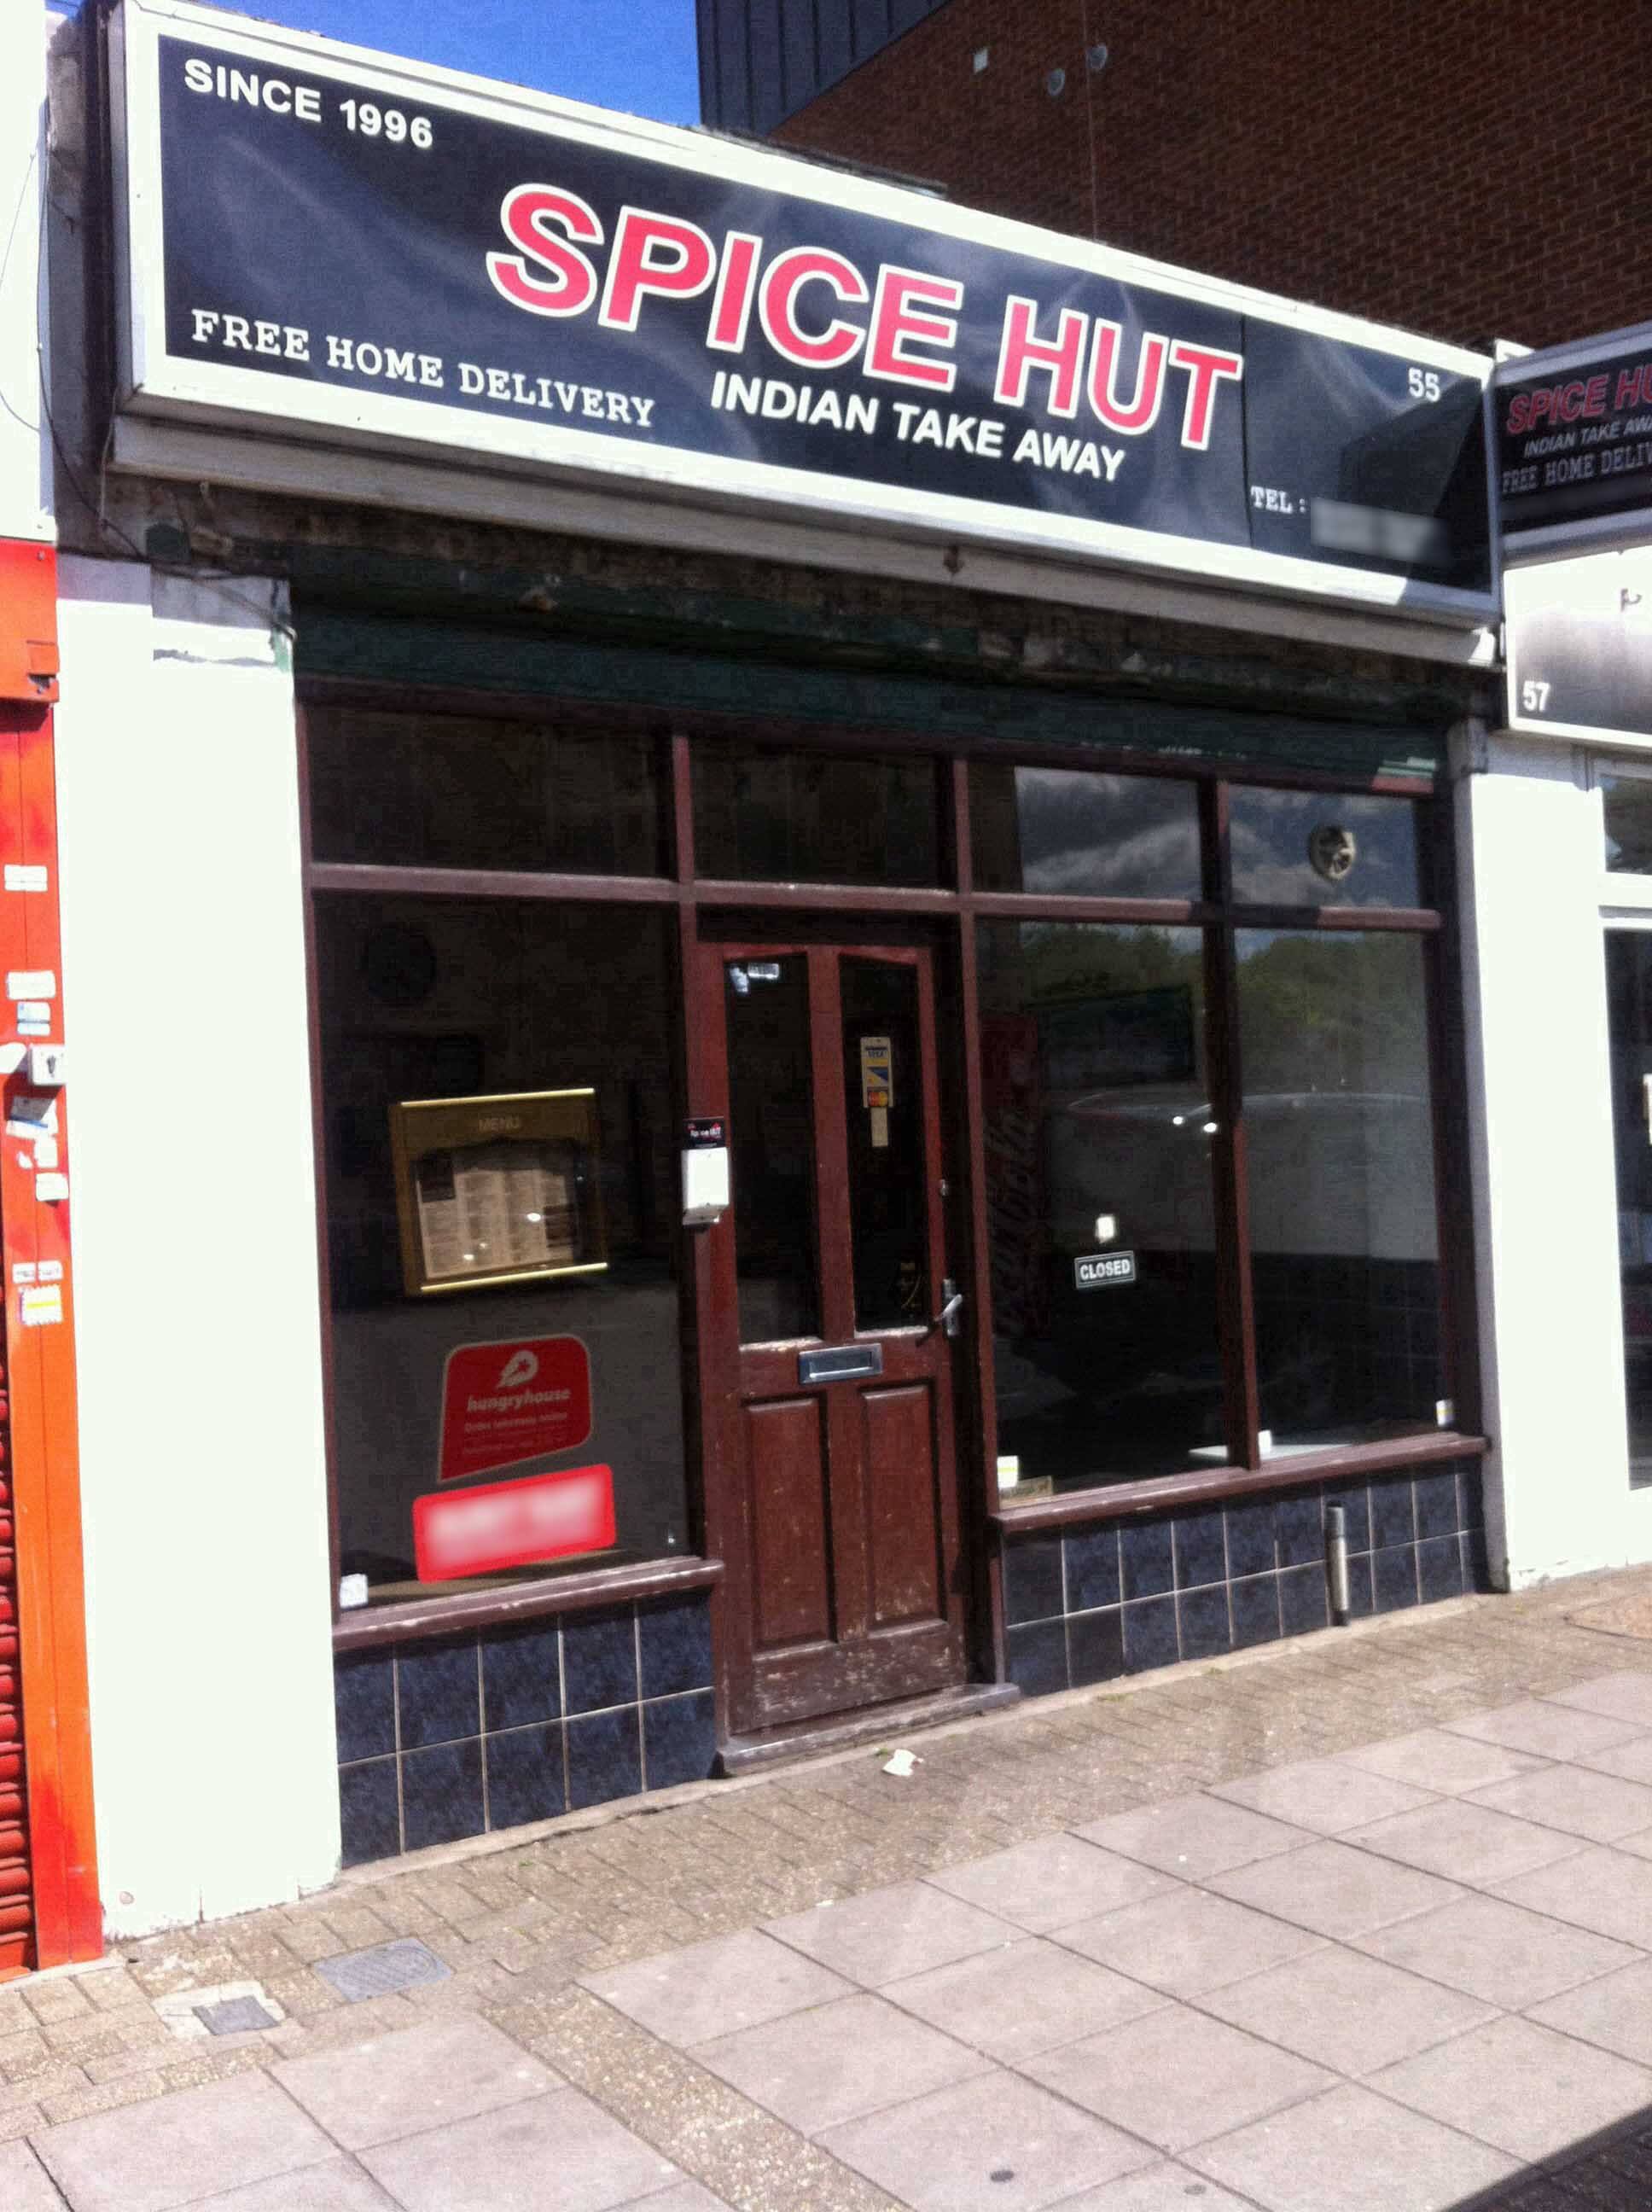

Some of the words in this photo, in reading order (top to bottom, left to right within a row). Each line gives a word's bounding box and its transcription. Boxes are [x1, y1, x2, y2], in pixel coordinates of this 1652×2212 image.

[183, 58, 323, 123] SINCE
[339, 99, 433, 148] 1996
[486, 183, 964, 393] SPICE
[993, 294, 1244, 451] HUT
[190, 309, 310, 362] FREE
[326, 335, 444, 388] HOME
[458, 363, 655, 428] DELIVERY
[1407, 367, 1440, 403] 55
[1507, 374, 1610, 434] SPICE
[710, 370, 879, 434] INDIAN
[893, 402, 1005, 458] TAKE
[1012, 428, 1126, 482] AWAY
[1524, 434, 1575, 457] INDIAN
[1580, 421, 1620, 445] TAKE
[1502, 465, 1539, 492] FREE
[1545, 454, 1597, 485] HOME
[1250, 486, 1294, 514] TEL
[1521, 681, 1551, 712] 57
[1080, 1259, 1131, 1279] CLOSED
